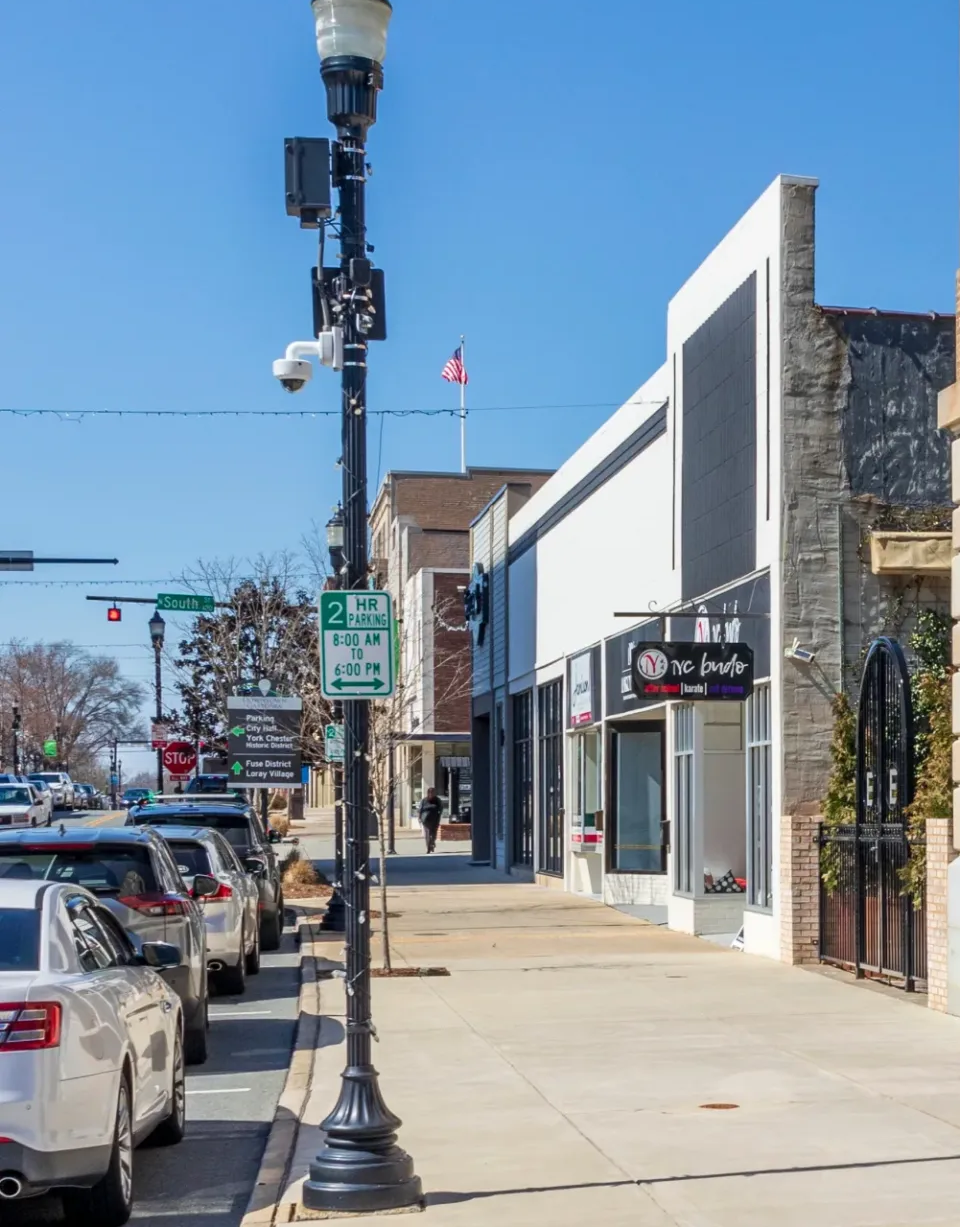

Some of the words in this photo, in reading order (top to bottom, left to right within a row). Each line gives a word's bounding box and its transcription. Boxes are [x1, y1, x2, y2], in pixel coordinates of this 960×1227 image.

[163, 596, 199, 610] South
[328, 602, 344, 624] 2
[356, 598, 378, 611] HR
[349, 613, 387, 626] PARKING
[333, 633, 359, 647] 8:00
[364, 633, 381, 646] AM
[351, 648, 363, 660] TO
[334, 663, 361, 677] 6:00
[365, 663, 381, 676] PM
[684, 683, 704, 693] karate
[246, 715, 275, 724] Parking
[246, 725, 261, 733] City
[165, 752, 196, 765] STOP
[246, 770, 268, 779] Loray
[269, 770, 294, 779] Village
